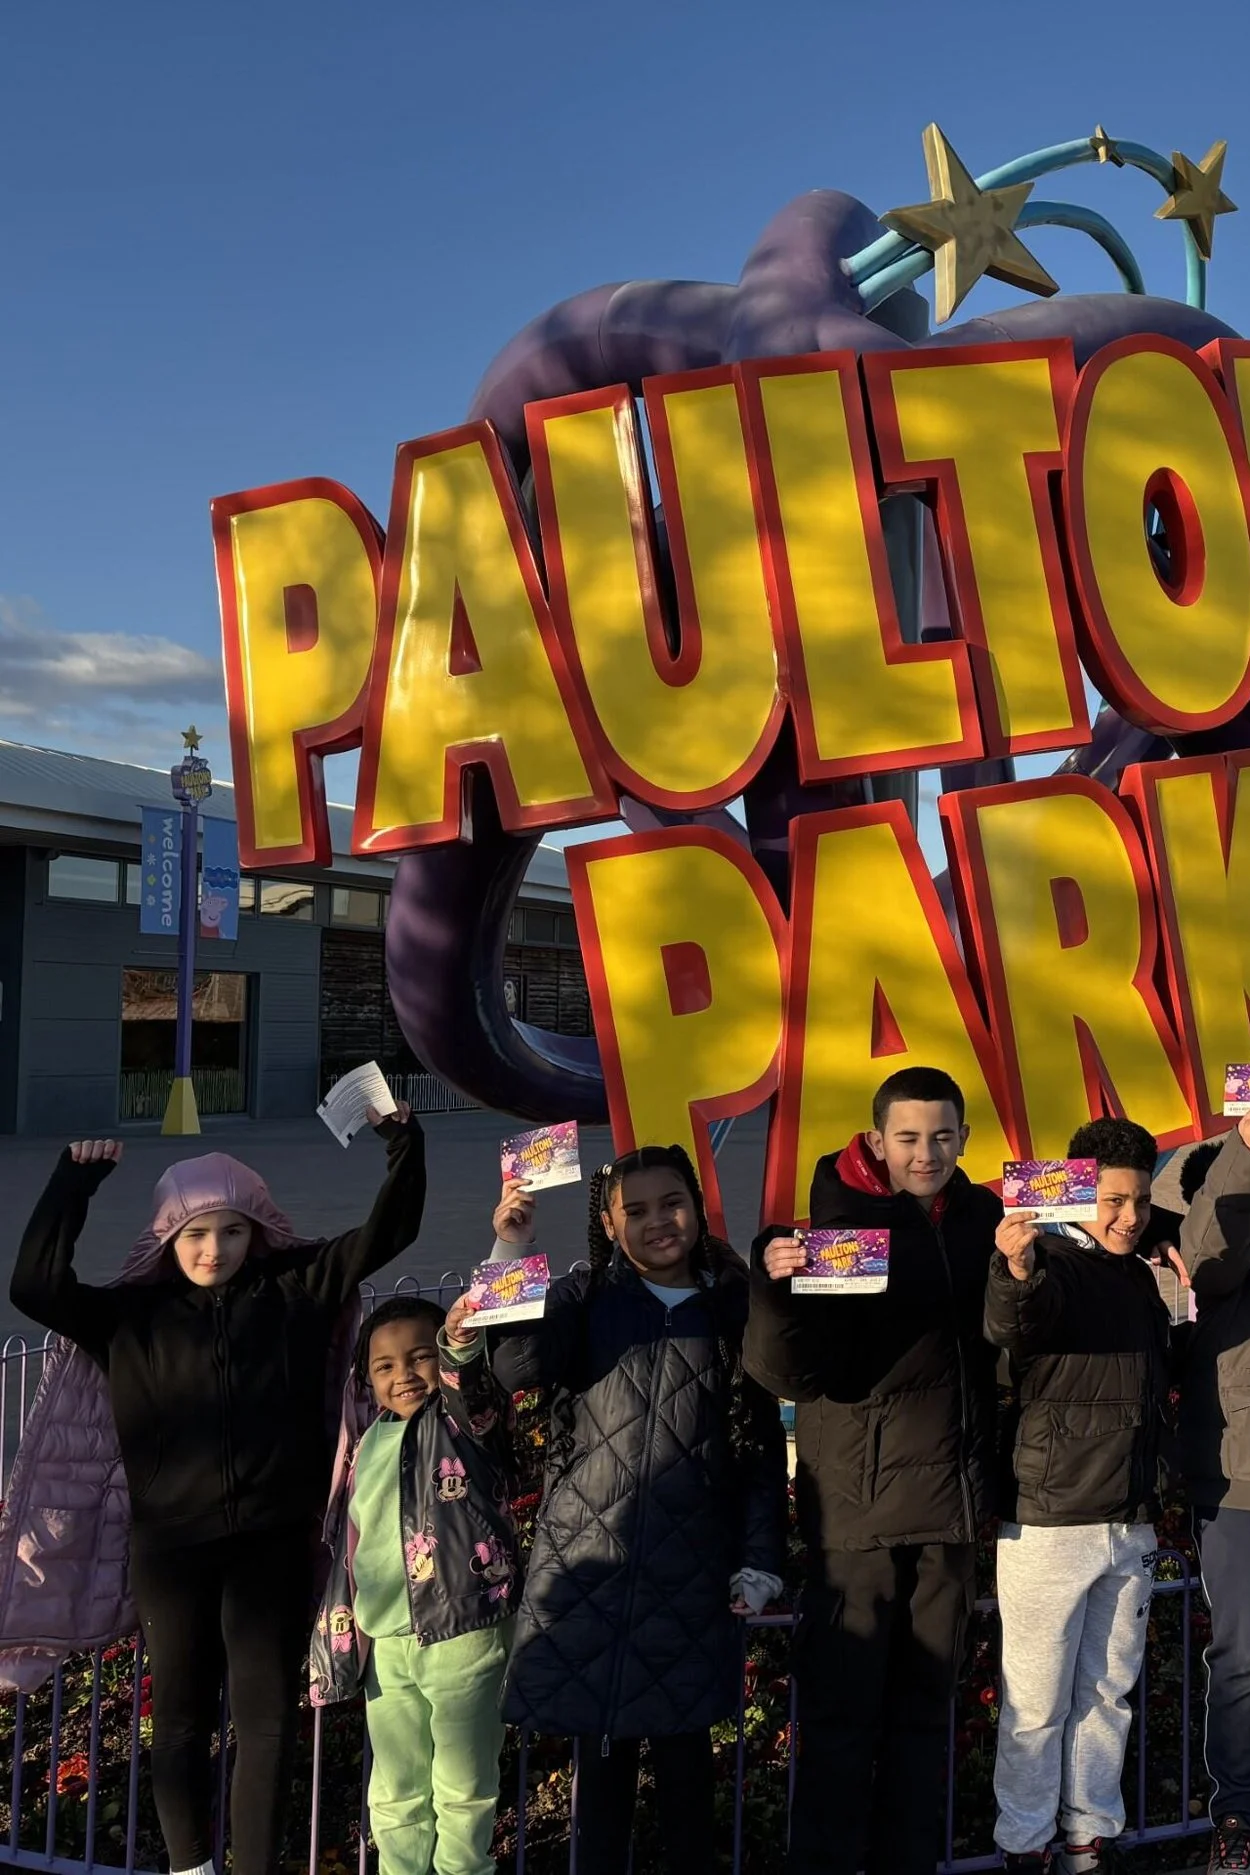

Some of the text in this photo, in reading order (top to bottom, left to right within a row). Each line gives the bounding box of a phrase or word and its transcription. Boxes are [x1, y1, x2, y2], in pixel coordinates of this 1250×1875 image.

[161, 816, 179, 928] welcome
[520, 1136, 553, 1162] PAULTONS
[531, 1150, 550, 1169] PARK
[1029, 1169, 1068, 1192] PAULTONS
[1042, 1183, 1063, 1201] PARK
[820, 1240, 859, 1262] PAULTONS
[832, 1254, 854, 1271] PARK
[490, 1268, 525, 1294] PAULTONS
